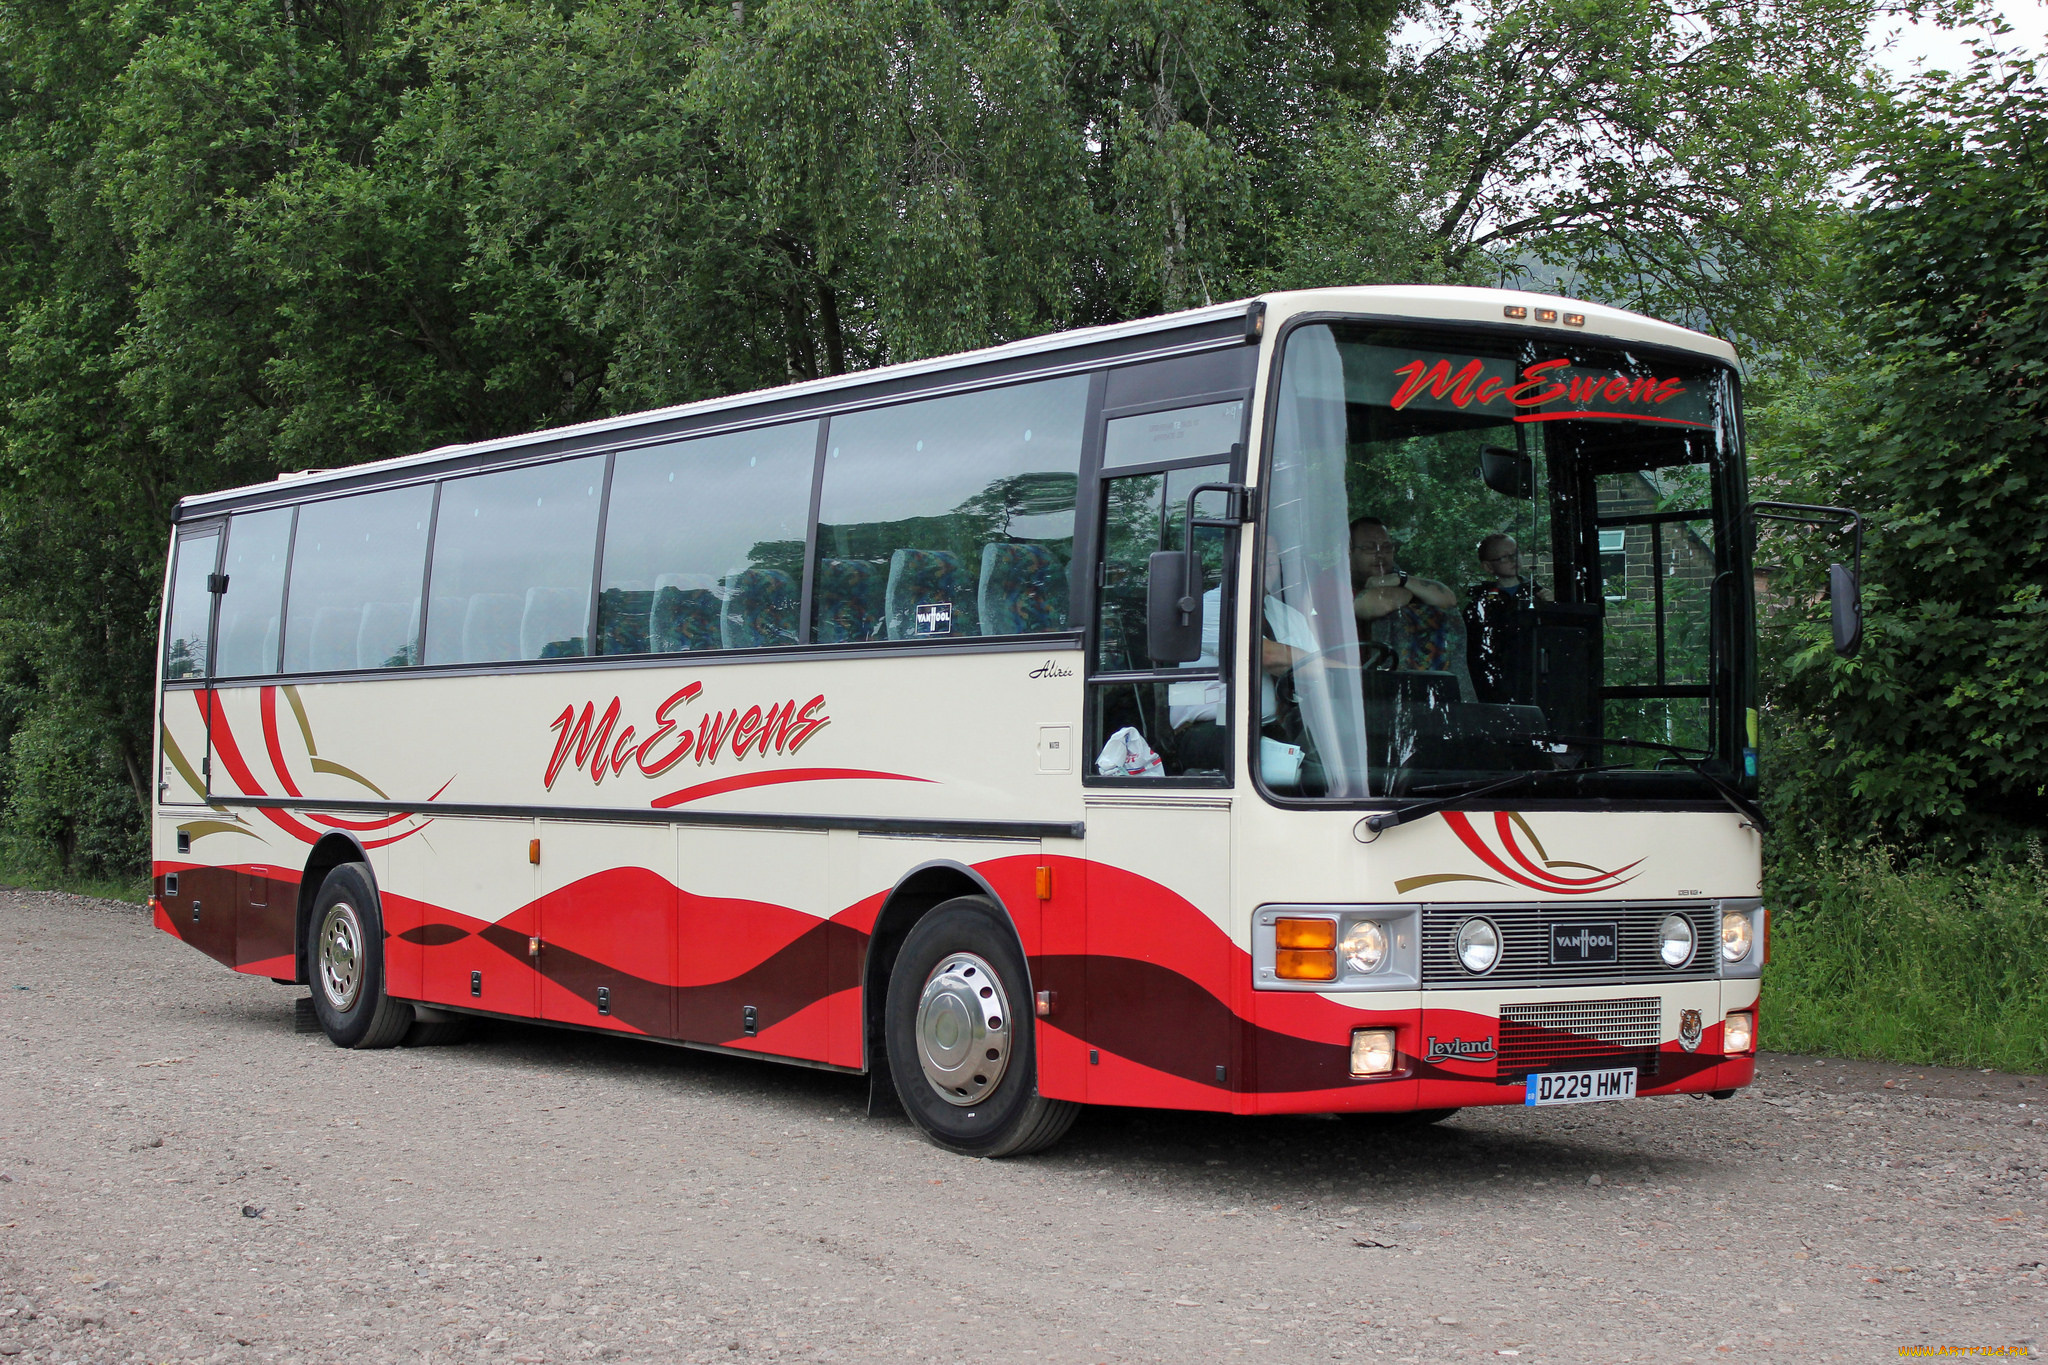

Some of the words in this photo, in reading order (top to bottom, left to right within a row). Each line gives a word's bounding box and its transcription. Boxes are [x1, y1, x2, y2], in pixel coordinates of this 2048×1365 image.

[1390, 358, 1687, 411] McEwens
[543, 680, 832, 792] McEwens
[1424, 1036, 1498, 1063] Leyland
[1540, 1074, 1592, 1100] D229
[1597, 1070, 1633, 1097] HMT
